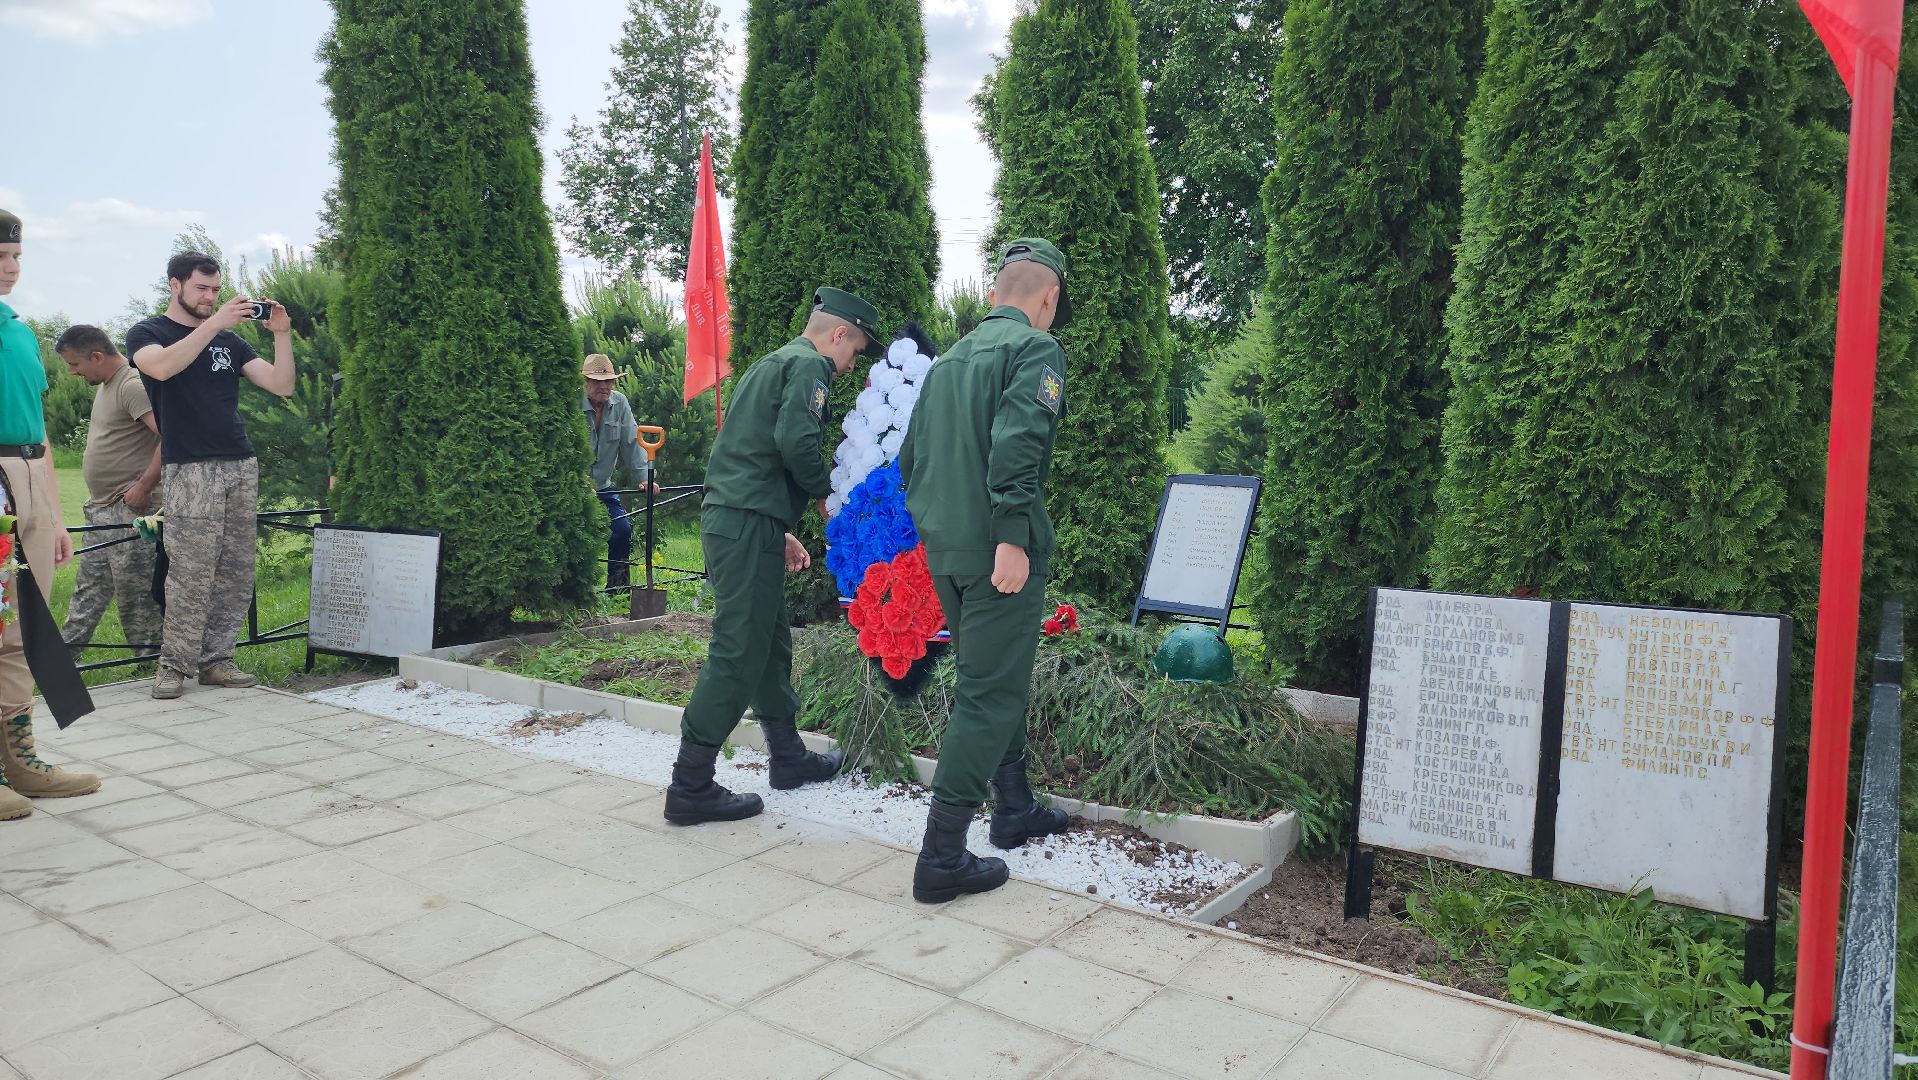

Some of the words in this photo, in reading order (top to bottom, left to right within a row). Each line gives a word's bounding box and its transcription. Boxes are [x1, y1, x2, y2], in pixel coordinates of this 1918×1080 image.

[1424, 624, 1496, 642] БОГДАНОВ
[1418, 689, 1467, 706] ЕРШОВ
[1625, 684, 1678, 702] ПОПОВ
[1418, 702, 1505, 724] ЖИЛЬНИКОВ
[1416, 728, 1469, 746] КОЗЛОВ
[1623, 727, 1720, 751] СТРЕЛЬЧУК
[1415, 740, 1478, 761] КОСАРЕВ
[1412, 780, 1479, 802] КУЛЕМИН
[1411, 792, 1483, 816] ЛЕКАНЦЕВ
